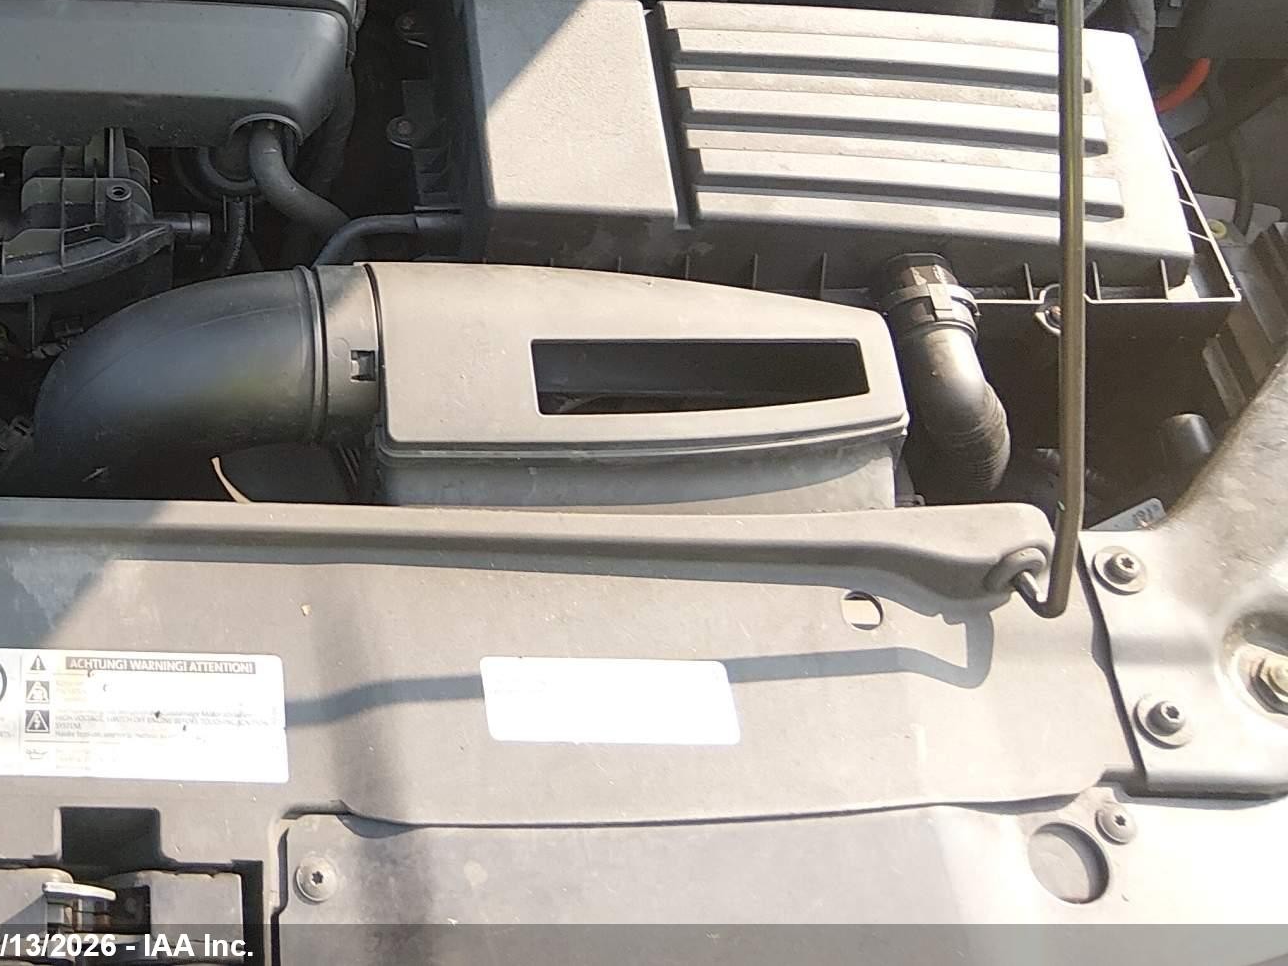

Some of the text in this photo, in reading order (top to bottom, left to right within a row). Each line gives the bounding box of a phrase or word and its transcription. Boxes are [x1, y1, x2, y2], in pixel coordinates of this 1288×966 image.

[69, 658, 254, 675] ACHTUNG! WARNING! ATTENTION!
